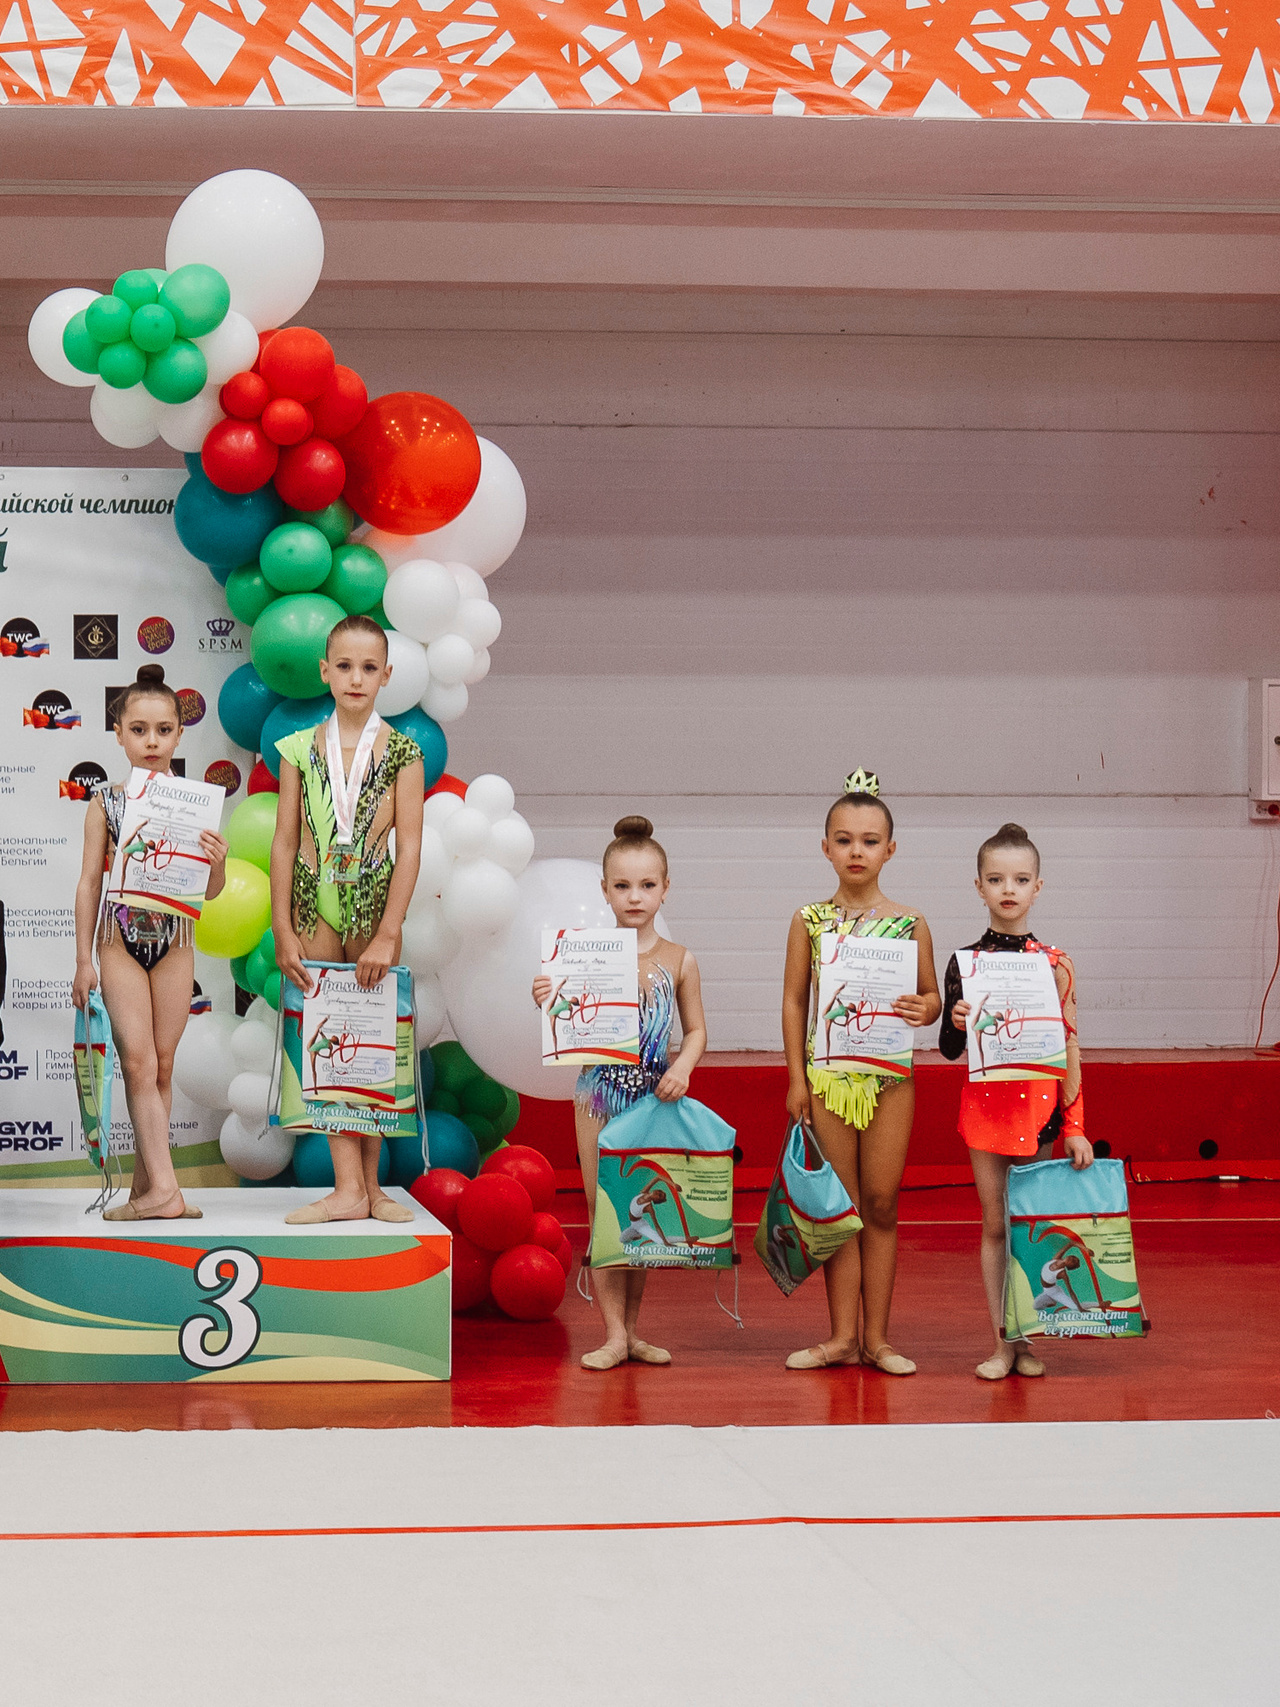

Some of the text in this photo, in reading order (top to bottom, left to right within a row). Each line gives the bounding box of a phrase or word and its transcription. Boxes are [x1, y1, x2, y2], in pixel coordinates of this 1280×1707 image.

[198, 638, 242, 650] SPSM
[145, 779, 210, 806] Грамота
[2, 857, 48, 866] Бельгии
[18, 930, 29, 938] из
[128, 926, 138, 942] 3
[555, 938, 622, 956] Грамота
[836, 943, 903, 961] Грамота
[972, 958, 1038, 974] Грамота
[12, 979, 72, 989] Професси
[12, 991, 72, 999] гимнастич
[12, 1002, 47, 1011] ковры
[306, 1104, 399, 1120] Возможности
[312, 1119, 400, 1133] безграничны!
[624, 1244, 716, 1256] Возможности
[178, 1246, 264, 1370] 3
[1038, 1310, 1128, 1322] Возможности
[1044, 1324, 1128, 1338] безграничны!
